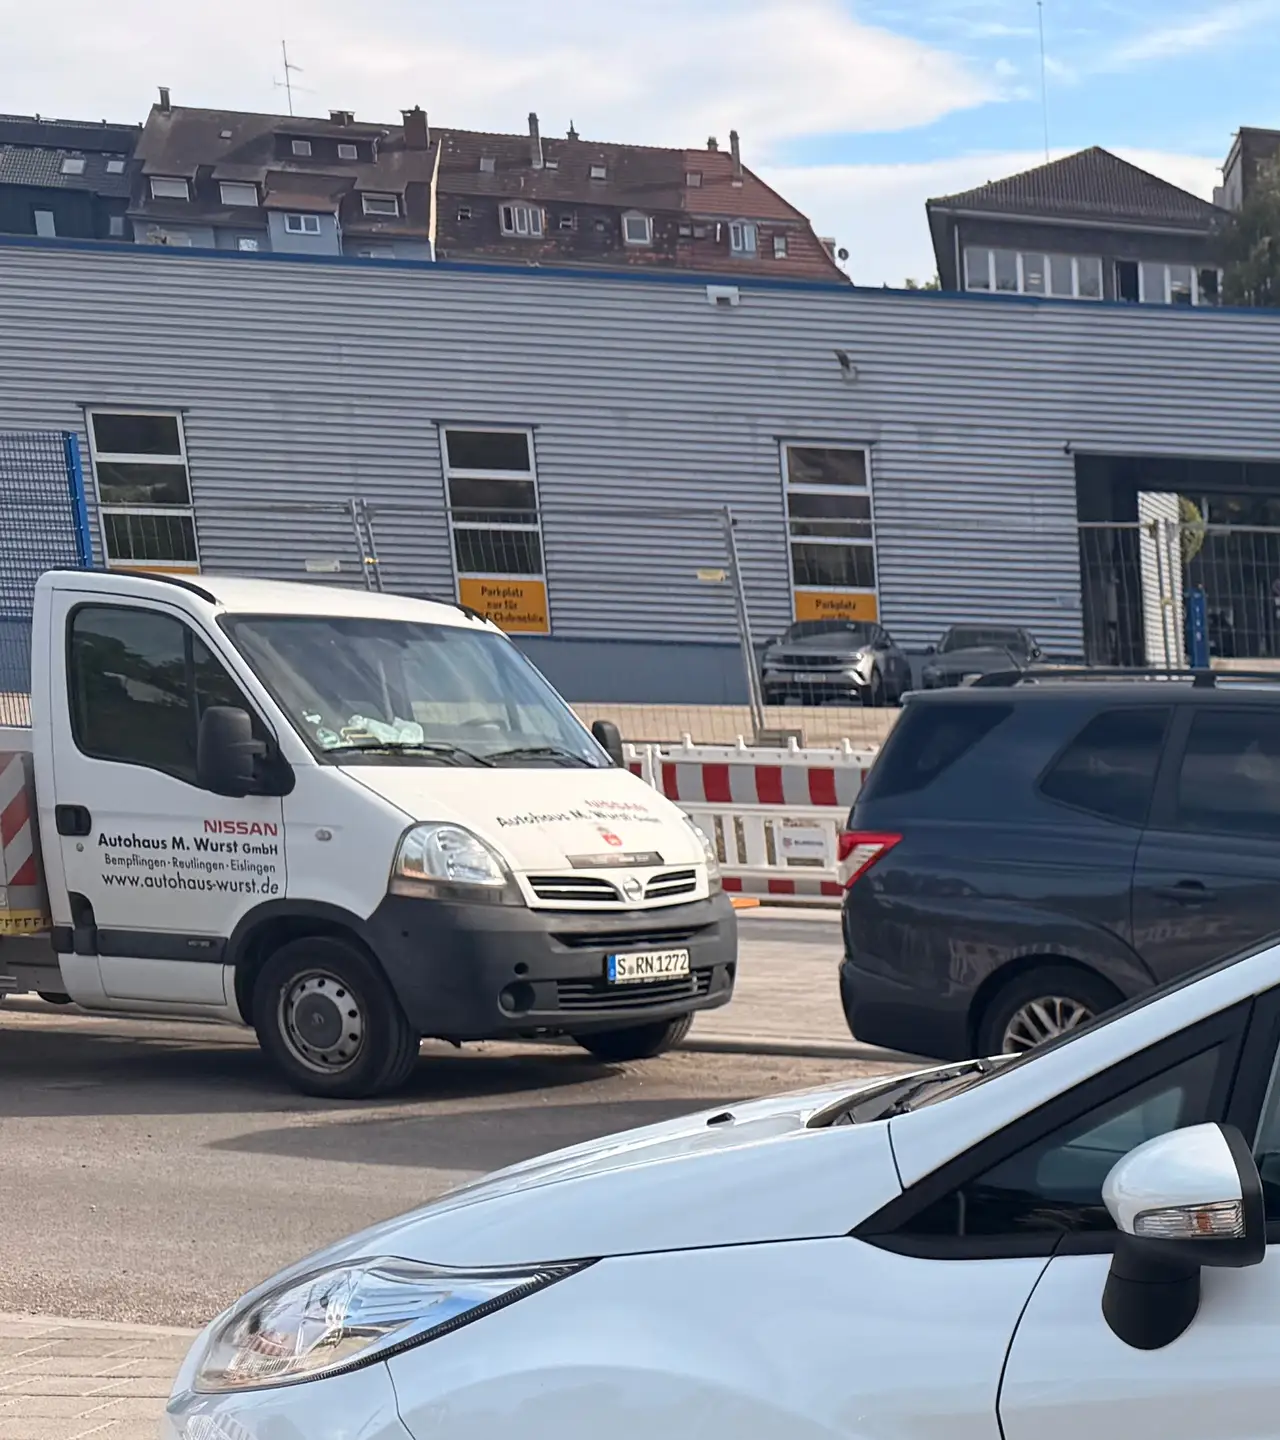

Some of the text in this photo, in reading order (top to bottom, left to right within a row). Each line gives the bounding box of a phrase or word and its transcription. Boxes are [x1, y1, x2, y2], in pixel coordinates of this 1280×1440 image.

[481, 586, 523, 598] Parkplatz
[203, 820, 278, 836] NISSAN
[98, 833, 278, 855] Autohaus M. Wurst GmbH
[105, 853, 276, 875] Bempflingen Reutlingen Eislingen
[102, 872, 279, 894] www.autohaus-wurst.de
